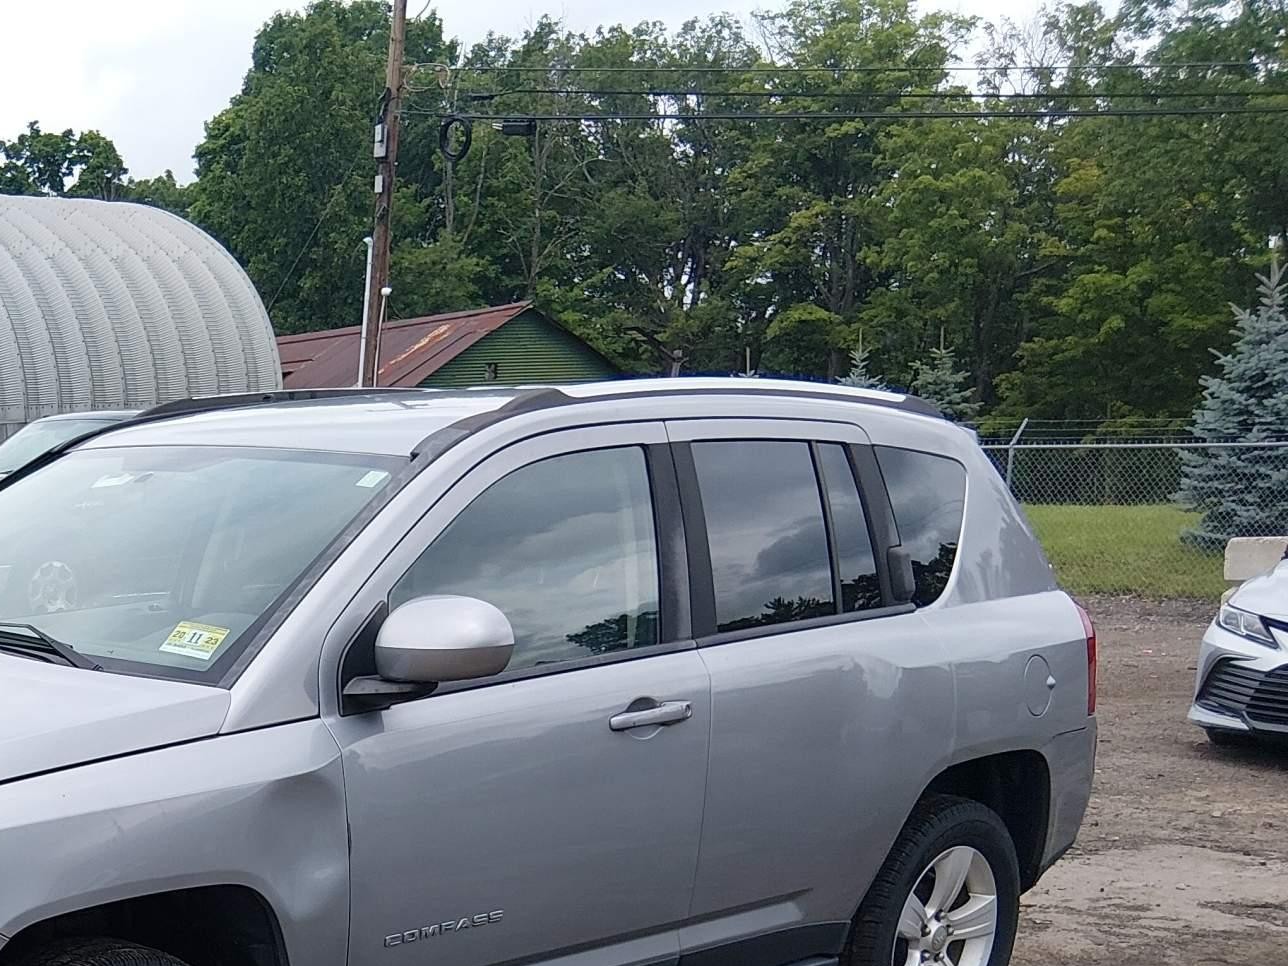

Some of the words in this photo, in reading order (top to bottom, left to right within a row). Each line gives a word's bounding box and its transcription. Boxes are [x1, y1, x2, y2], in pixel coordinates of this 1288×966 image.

[172, 630, 187, 639] 20
[186, 631, 203, 645] 11
[204, 636, 219, 646] 23
[384, 909, 504, 948] COMPASS
